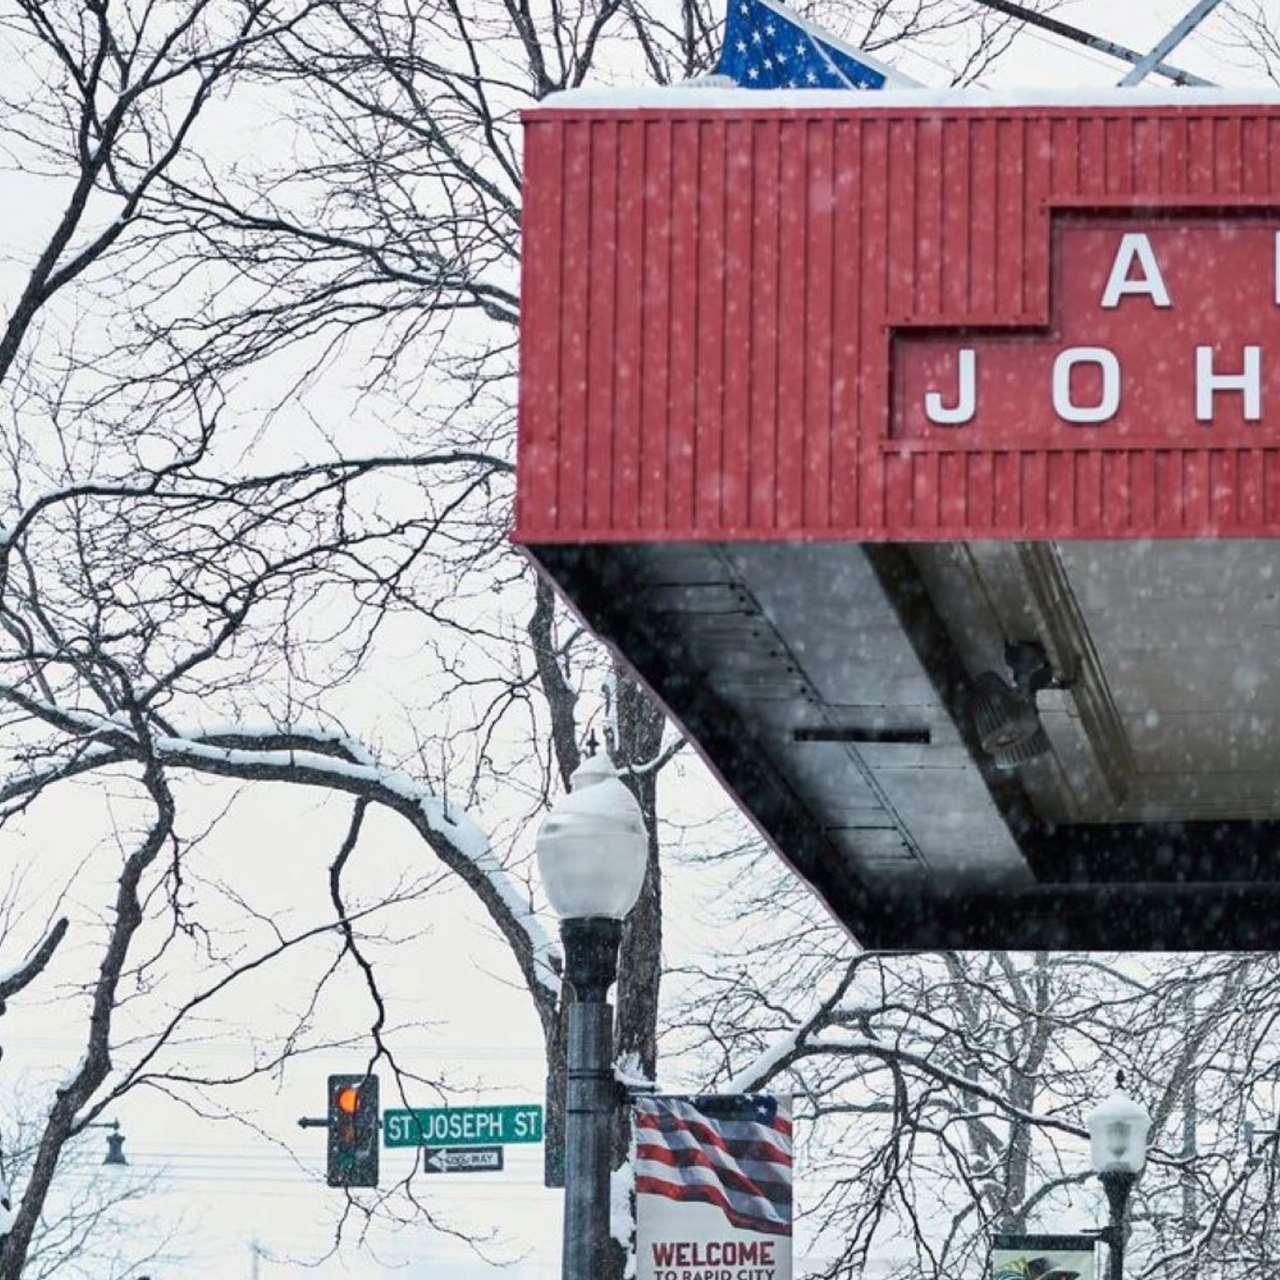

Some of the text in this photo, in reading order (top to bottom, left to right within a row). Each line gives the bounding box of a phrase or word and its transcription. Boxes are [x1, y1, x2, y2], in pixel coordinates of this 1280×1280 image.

[388, 1111, 538, 1141] ST JOSEPH ST
[651, 1241, 775, 1267] WELCOME
